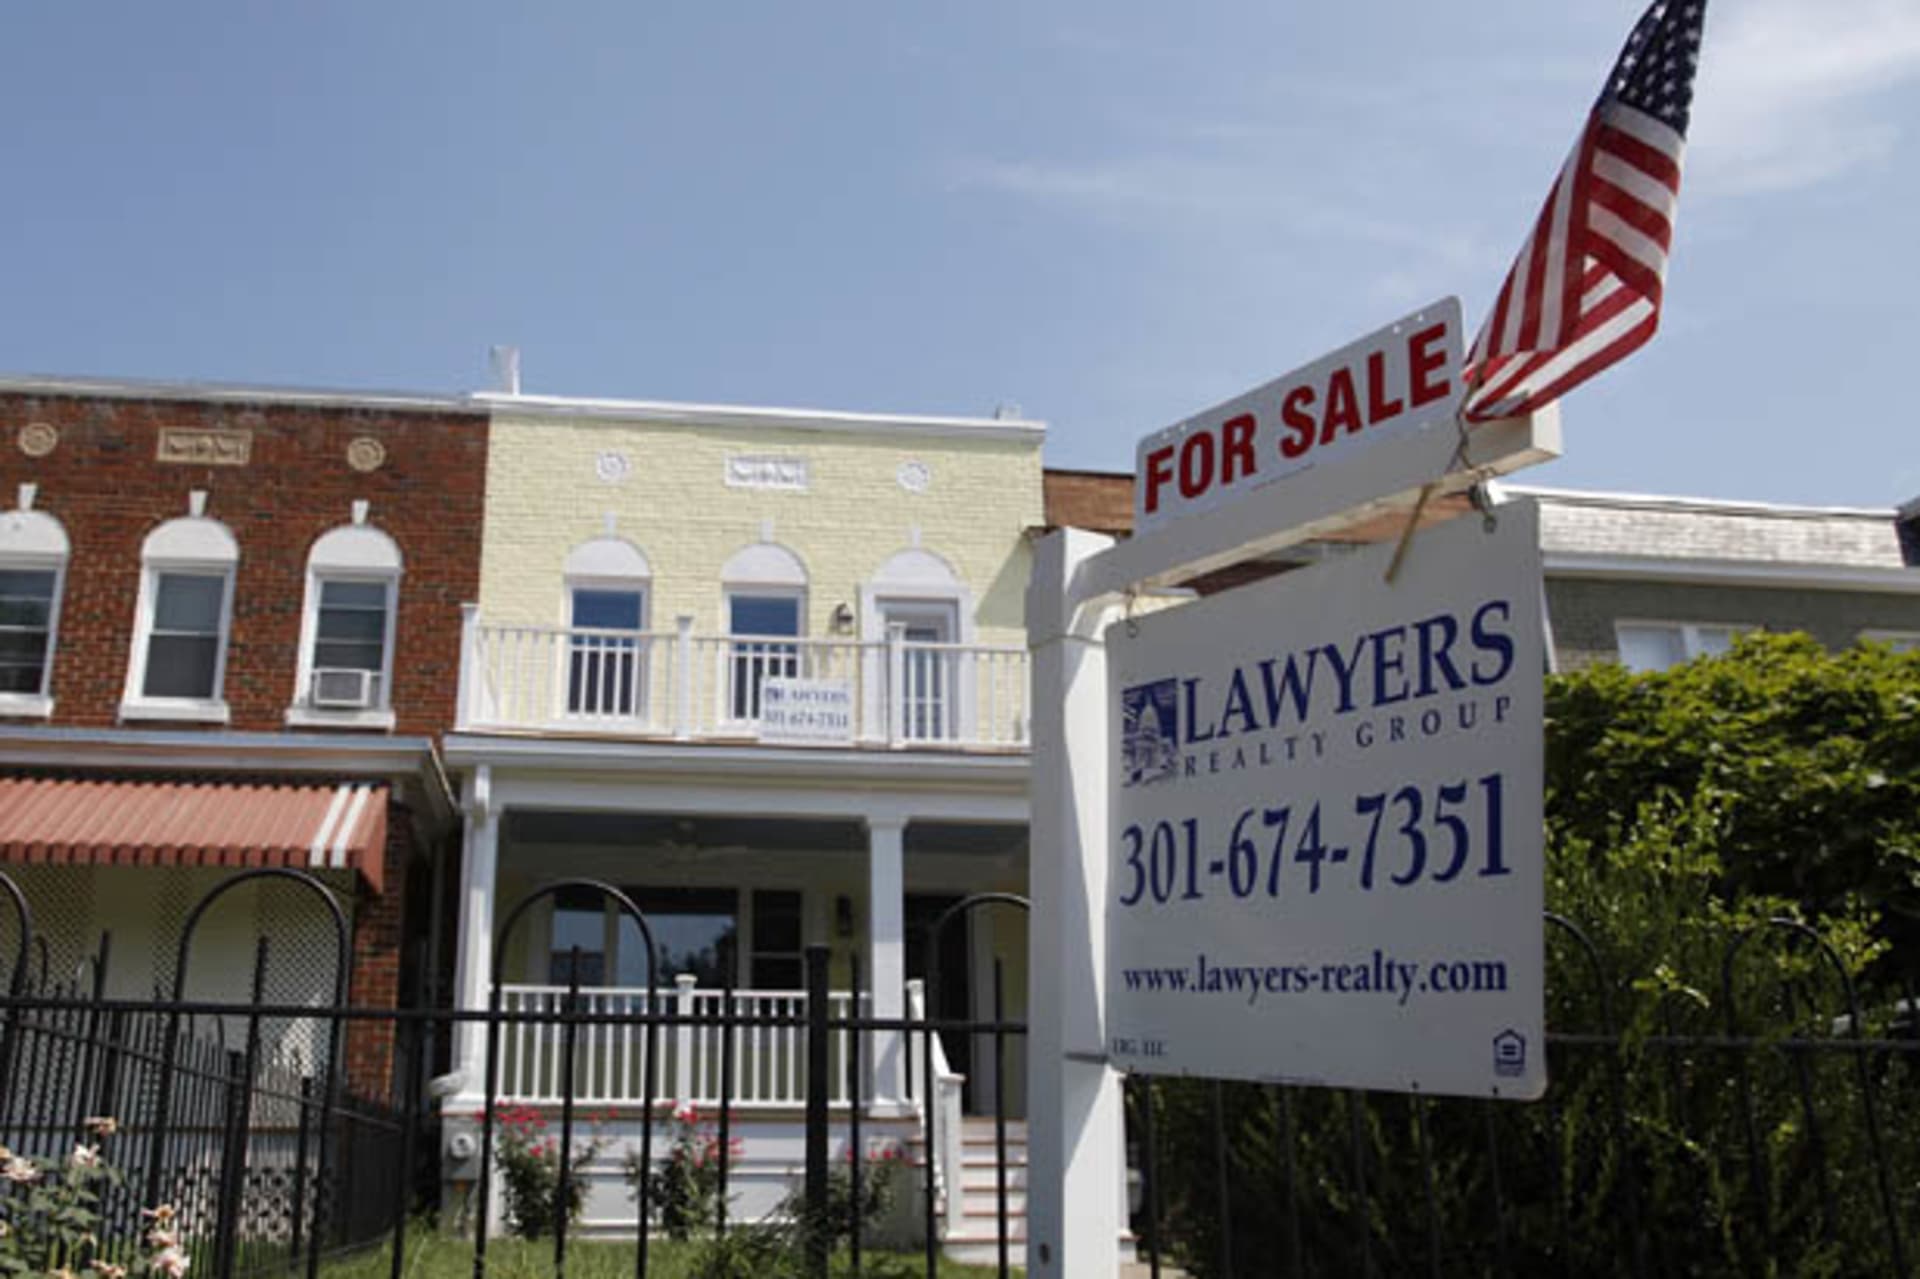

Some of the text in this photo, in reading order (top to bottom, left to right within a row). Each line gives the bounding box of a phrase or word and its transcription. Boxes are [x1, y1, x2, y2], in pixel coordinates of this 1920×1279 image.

[1144, 321, 1451, 515] FOR SALE
[1182, 600, 1515, 743] LAWYERS
[1184, 697, 1512, 777] REALTY GROUP
[1119, 772, 1512, 906] 301-674-7351
[1123, 949, 1508, 1006] www.lawyers-realty.com
